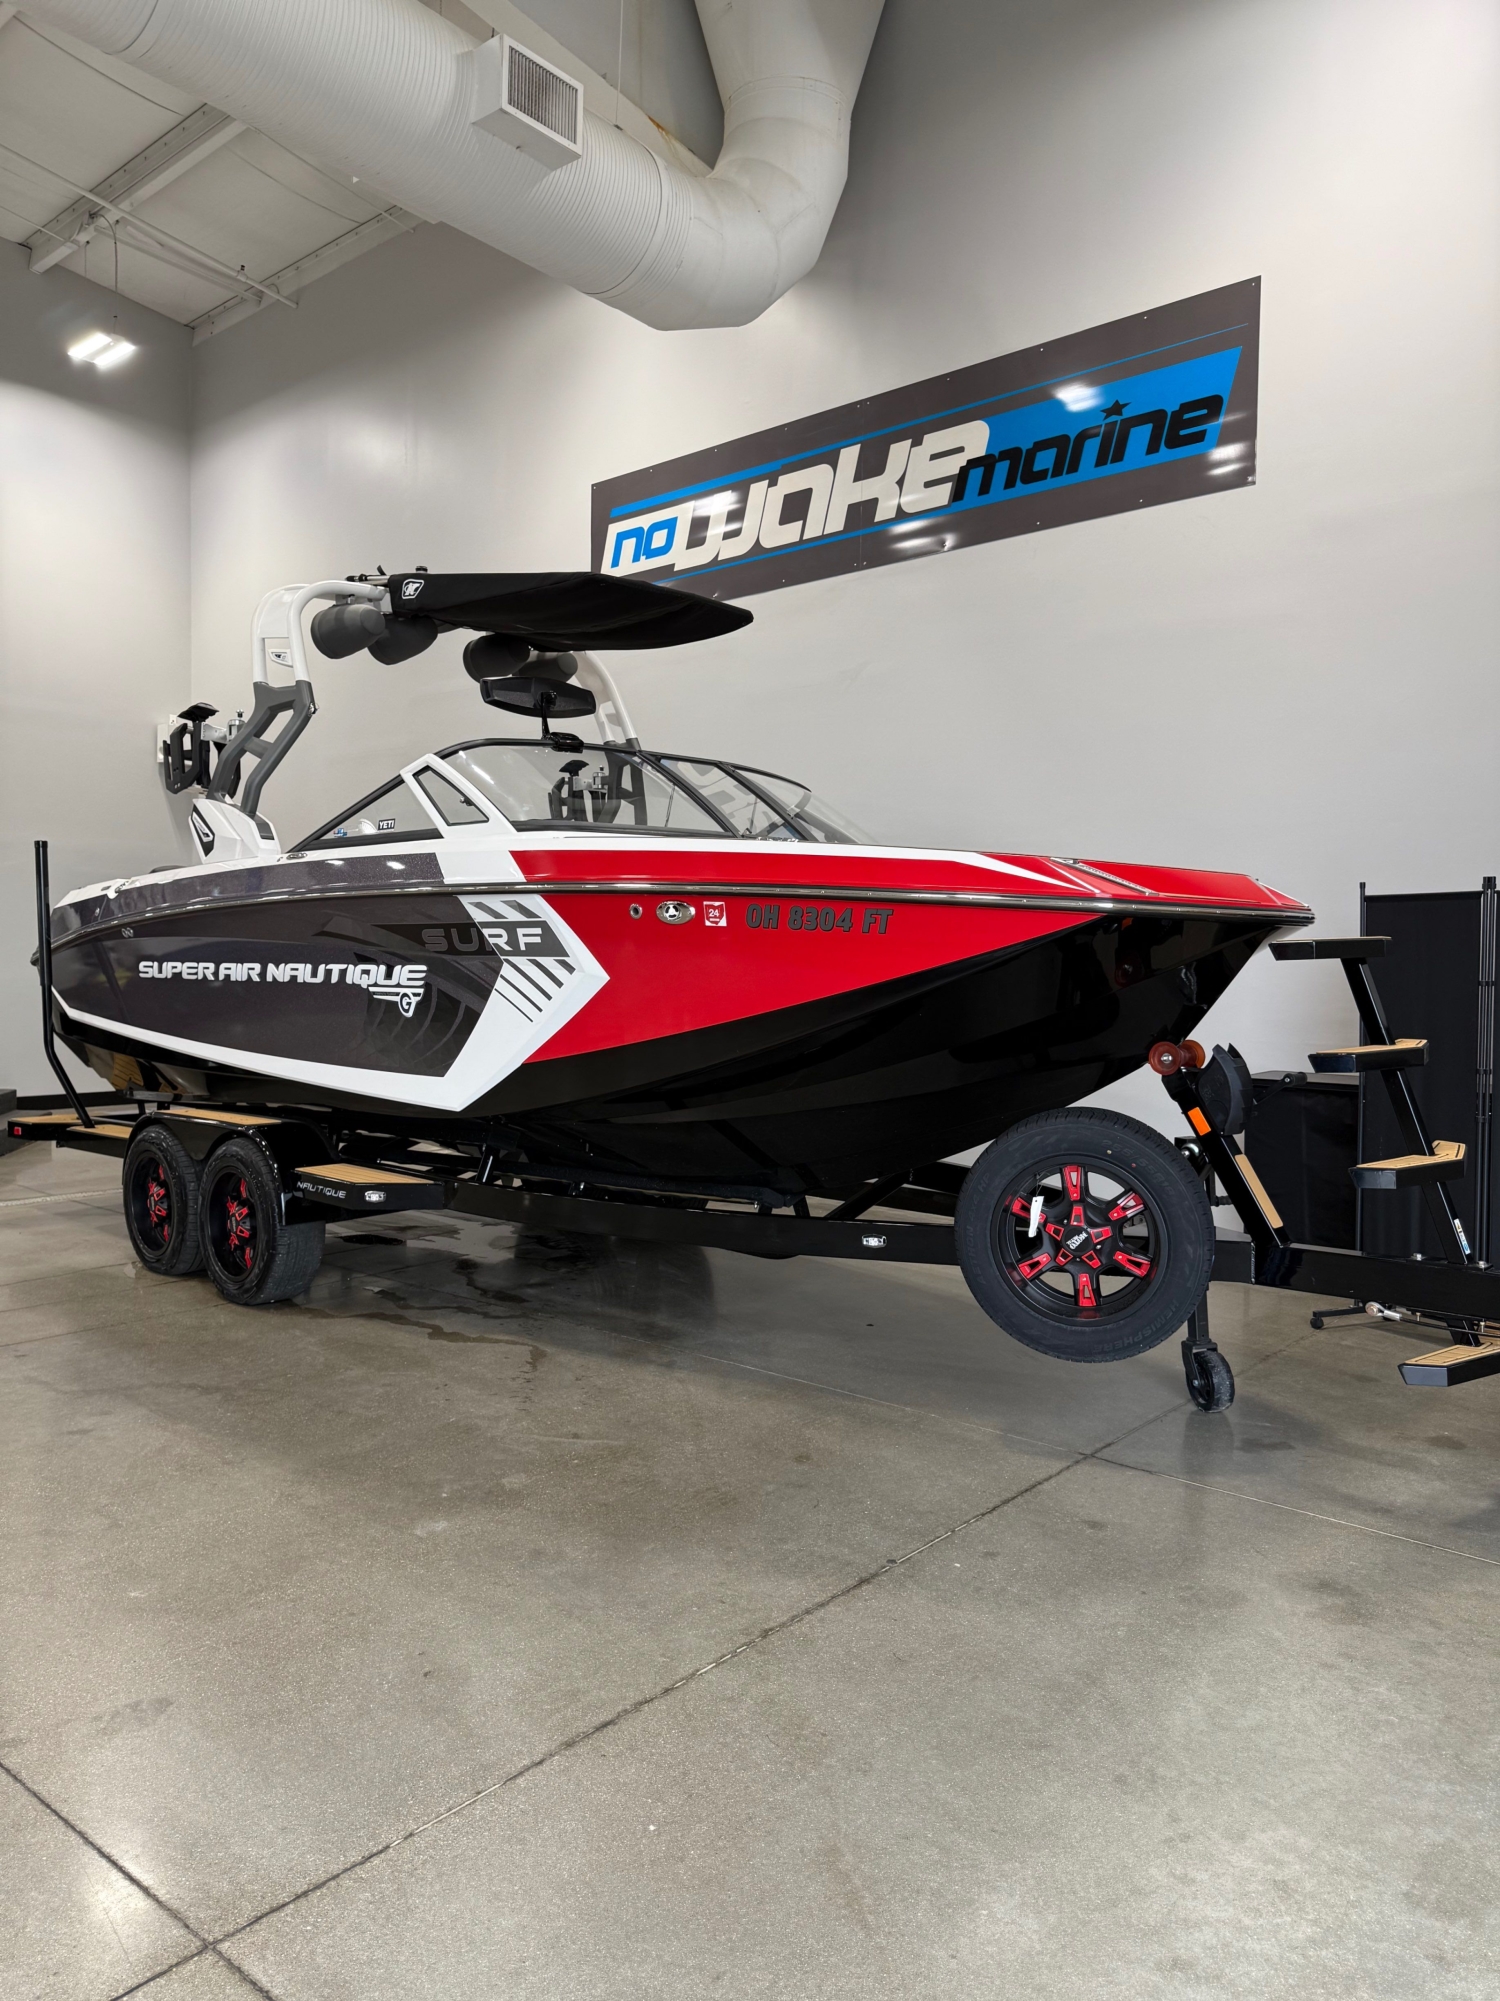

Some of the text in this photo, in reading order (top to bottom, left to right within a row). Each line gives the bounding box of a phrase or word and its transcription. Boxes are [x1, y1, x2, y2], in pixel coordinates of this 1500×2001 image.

[379, 820, 395, 830] YETI
[708, 908, 720, 918] 24
[745, 903, 894, 935] OH 8304 FT
[421, 927, 543, 952] SURF
[138, 961, 428, 989] SUPER AIR NAUTIQUE
[296, 1181, 347, 1199] NAUTIQUE
[977, 1172, 991, 1193] HP
[1092, 1298, 1180, 1354] HEMISPHERE
